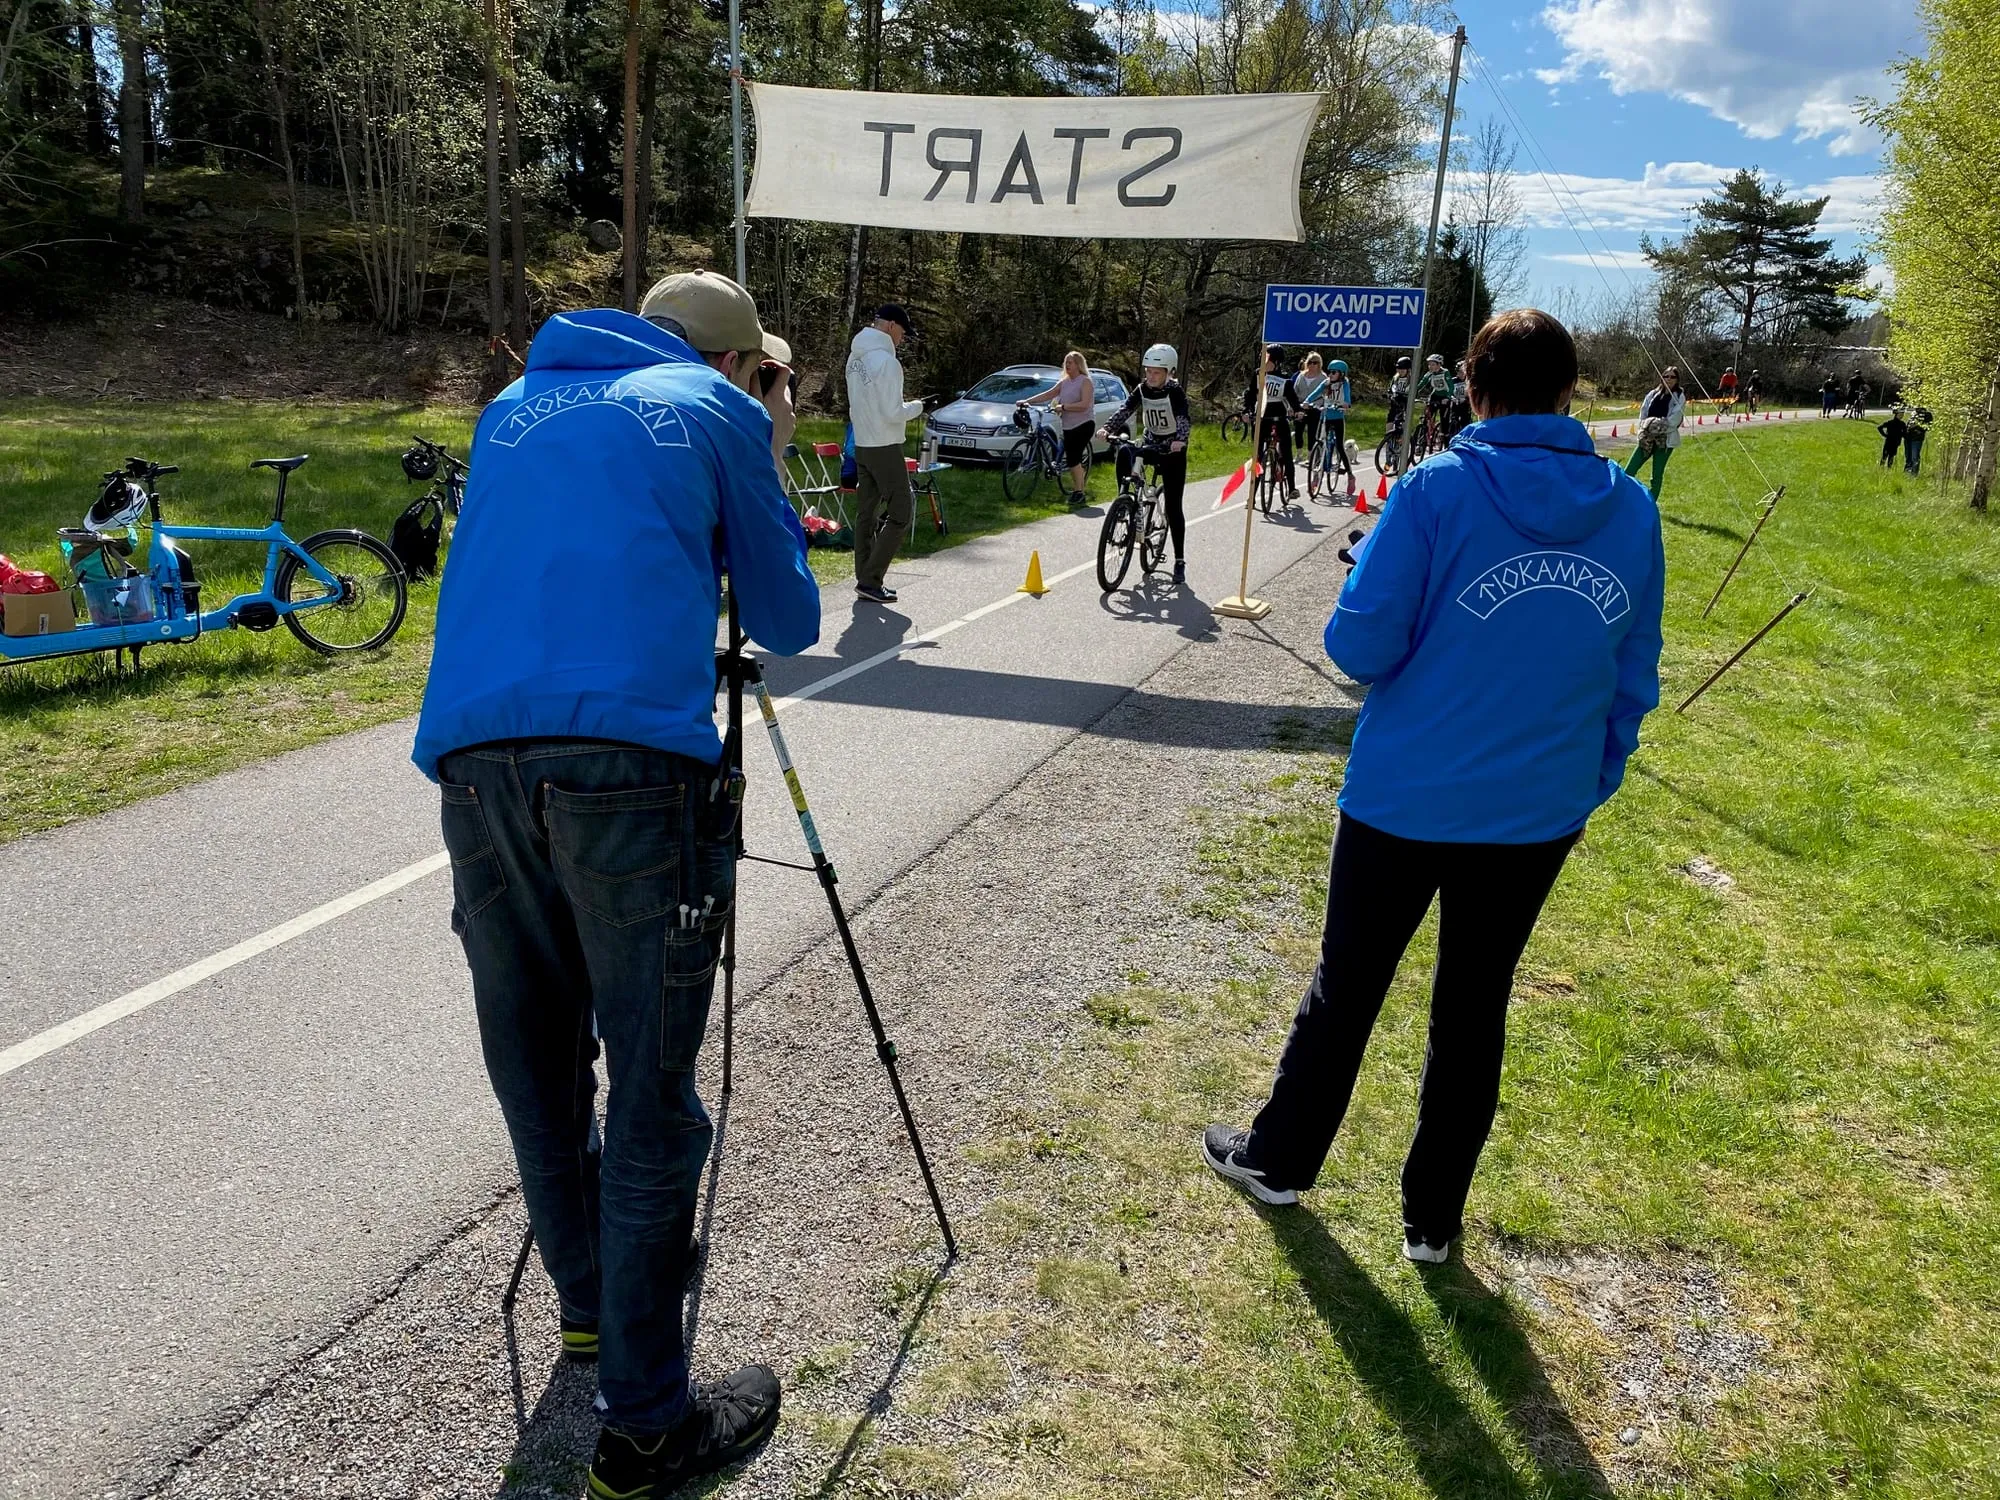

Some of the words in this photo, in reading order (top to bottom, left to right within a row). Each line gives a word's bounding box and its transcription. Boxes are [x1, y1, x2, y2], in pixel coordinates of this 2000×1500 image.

[1272, 292, 1420, 316] TIOKAMPEN
[1315, 318, 1371, 339] 2020
[1146, 409, 1169, 428] 105
[1479, 558, 1621, 611] TIOKAMPEN
